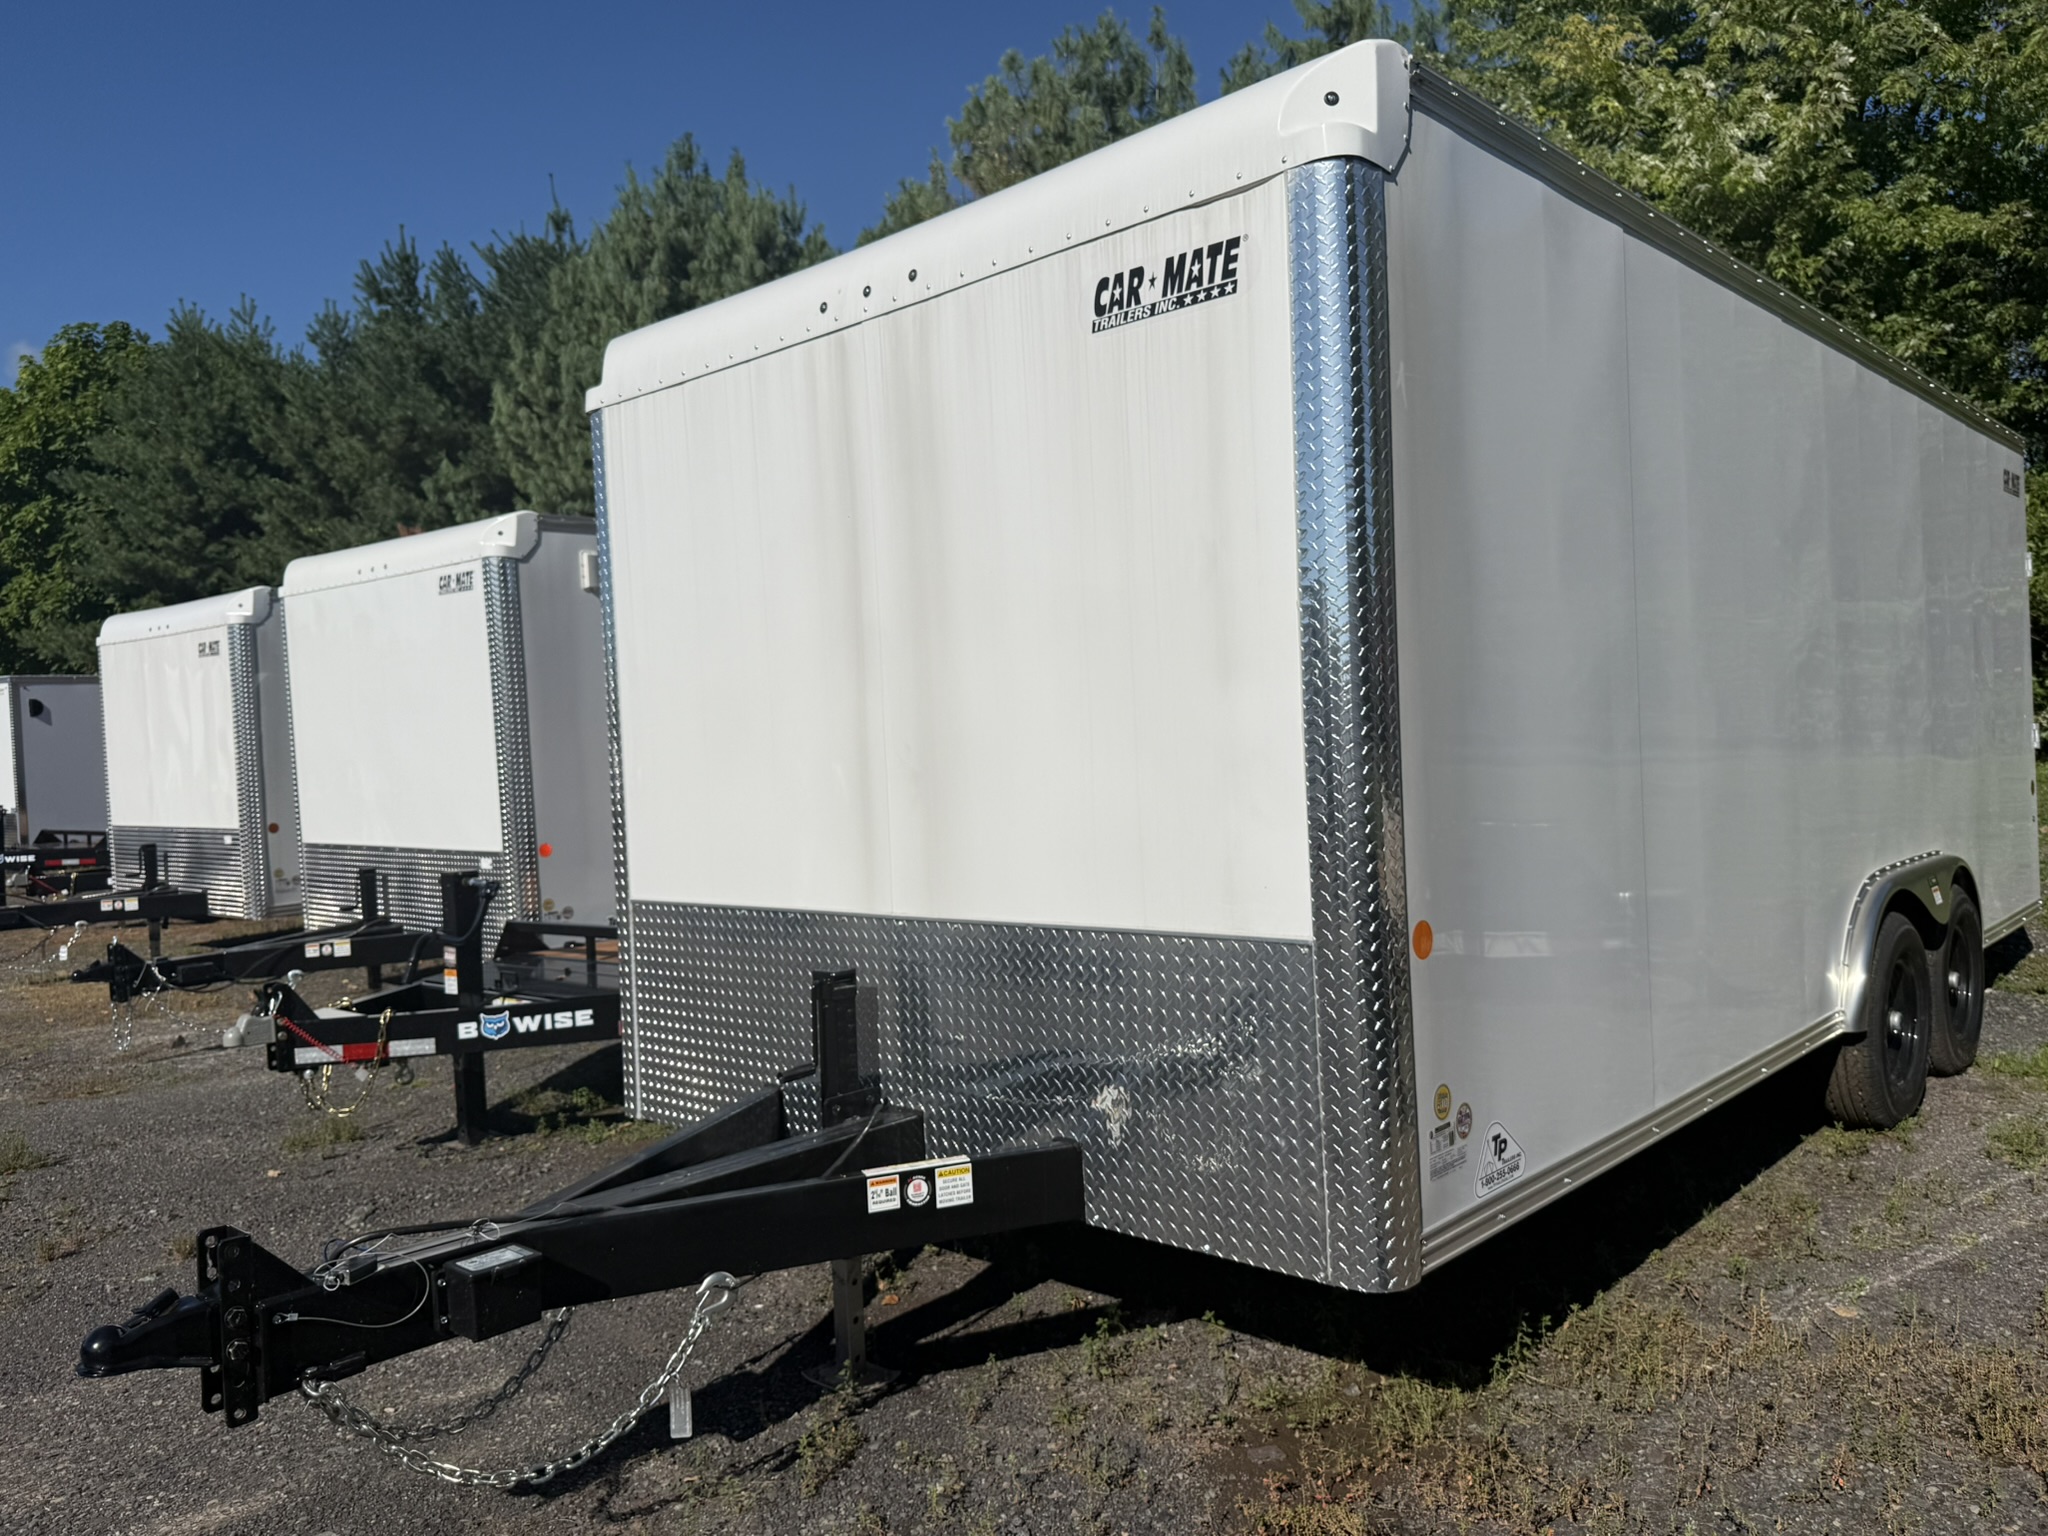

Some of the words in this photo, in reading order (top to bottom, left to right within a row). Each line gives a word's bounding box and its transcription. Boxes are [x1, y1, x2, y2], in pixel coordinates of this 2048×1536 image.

[1094, 266, 1145, 318] CAR
[1161, 235, 1241, 298] MATE
[1093, 305, 1152, 333] TRAILERS
[1154, 297, 1180, 315] INC.
[439, 575, 451, 590] CAR
[456, 570, 473, 587] MATE
[1492, 1133, 1507, 1161] TP
[943, 1167, 970, 1176] CAUTION
[885, 1187, 897, 1198] Ball
